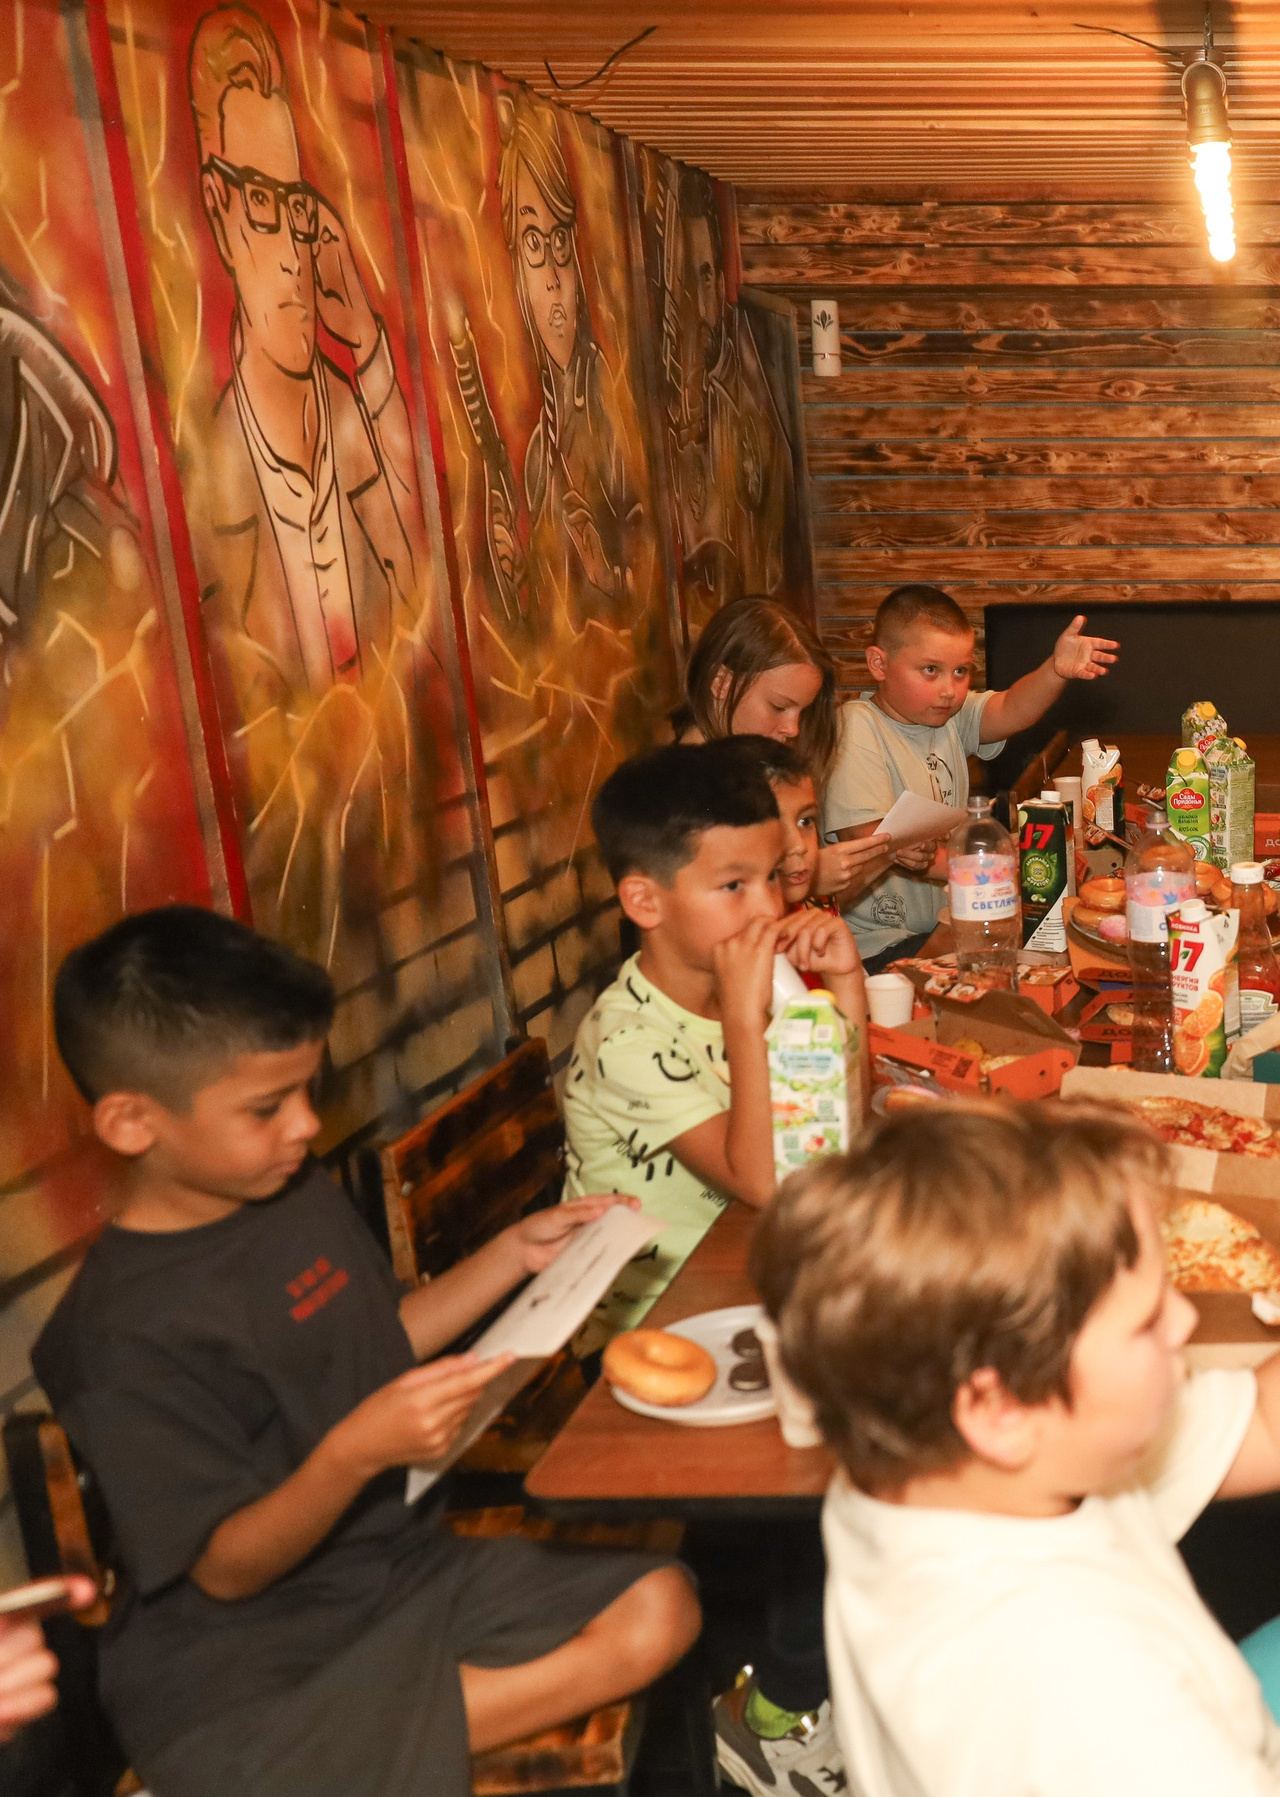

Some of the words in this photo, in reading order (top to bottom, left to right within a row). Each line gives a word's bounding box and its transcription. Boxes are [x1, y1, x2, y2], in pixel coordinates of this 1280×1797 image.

[1173, 798, 1202, 806] Придонья
[1019, 823, 1055, 850] J7
[1170, 938, 1204, 972] J7
[1172, 975, 1199, 984] НЕРГИЯ
[1172, 982, 1199, 992] РУКТОВ
